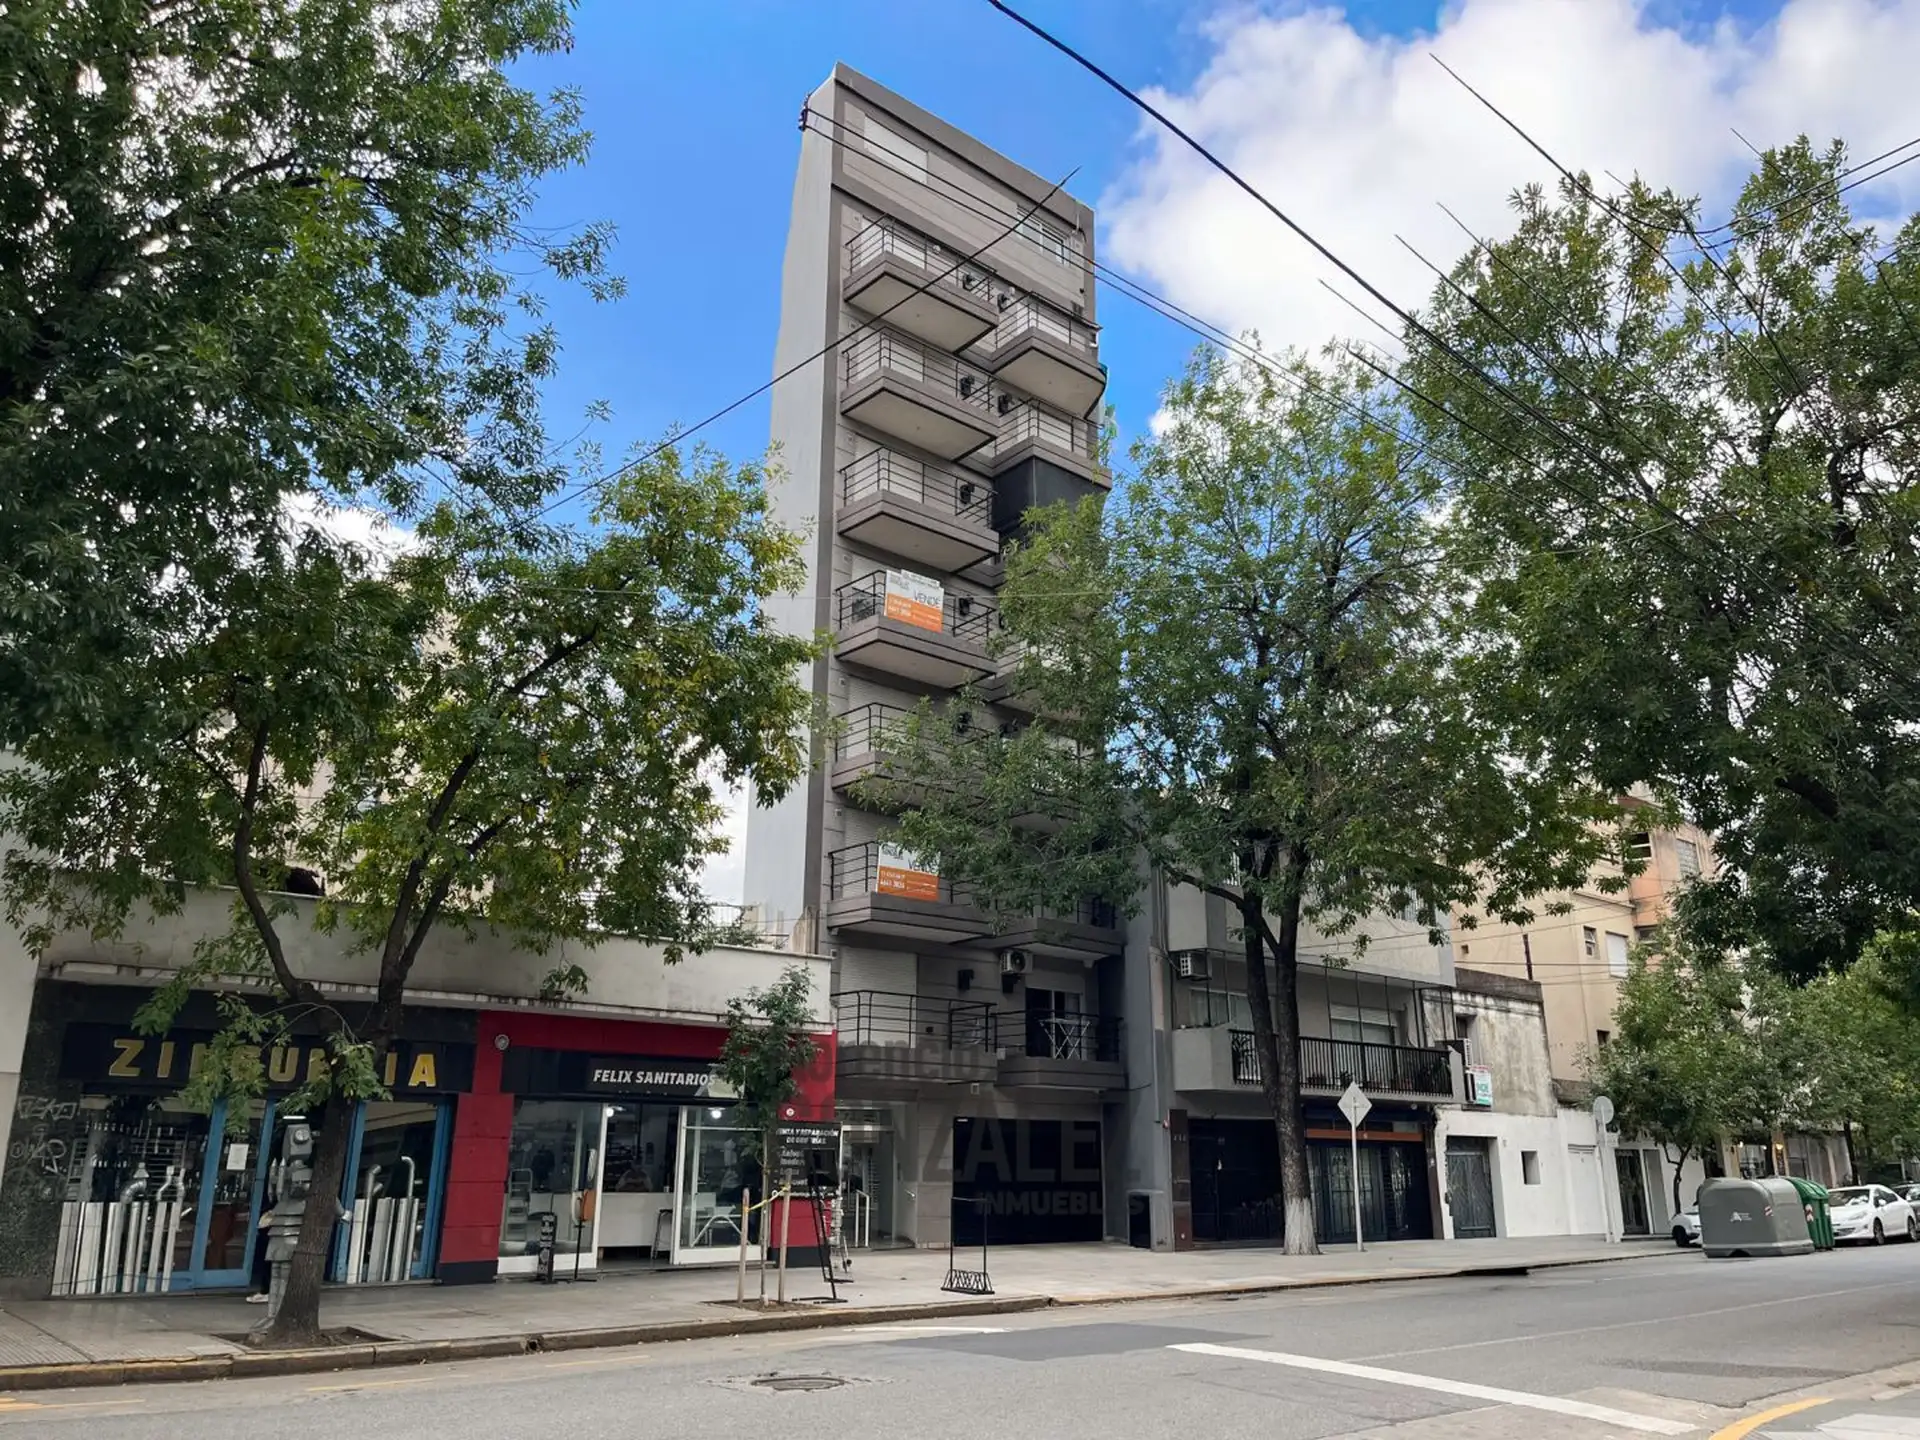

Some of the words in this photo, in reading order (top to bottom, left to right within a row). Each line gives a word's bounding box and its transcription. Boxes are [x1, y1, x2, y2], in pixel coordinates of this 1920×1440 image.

[108, 1039, 437, 1087] ZIUIA
[593, 1069, 633, 1083] FELIX
[635, 1071, 716, 1086] SANITARIOS
